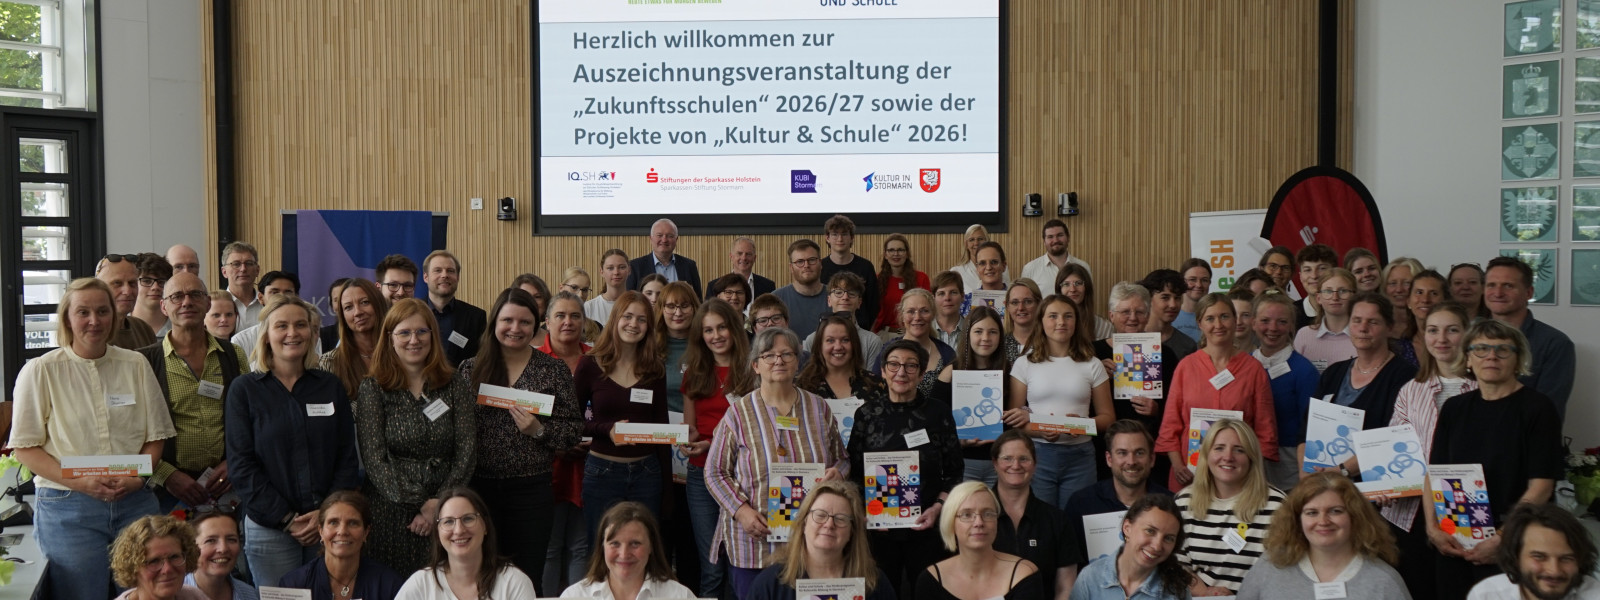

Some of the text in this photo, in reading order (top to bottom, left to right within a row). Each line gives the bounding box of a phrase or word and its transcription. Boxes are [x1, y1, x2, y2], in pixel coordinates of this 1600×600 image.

[573, 29, 835, 49] Herzlich willkommen zur
[573, 60, 952, 86] Auszeichnungsveranstaltung der
[573, 92, 976, 118] „Zukunftsschulen“ 2026/27 sowie der
[574, 123, 967, 149] Projekte von „Kultur & Schule“ 2026!
[568, 171, 595, 181] IQ.SH
[660, 176, 691, 184] Stiftungen
[704, 176, 734, 184] Sparkasse
[794, 174, 810, 182] KUBI
[874, 174, 911, 182] KULTUR IN
[1210, 239, 1235, 294] e.SH
